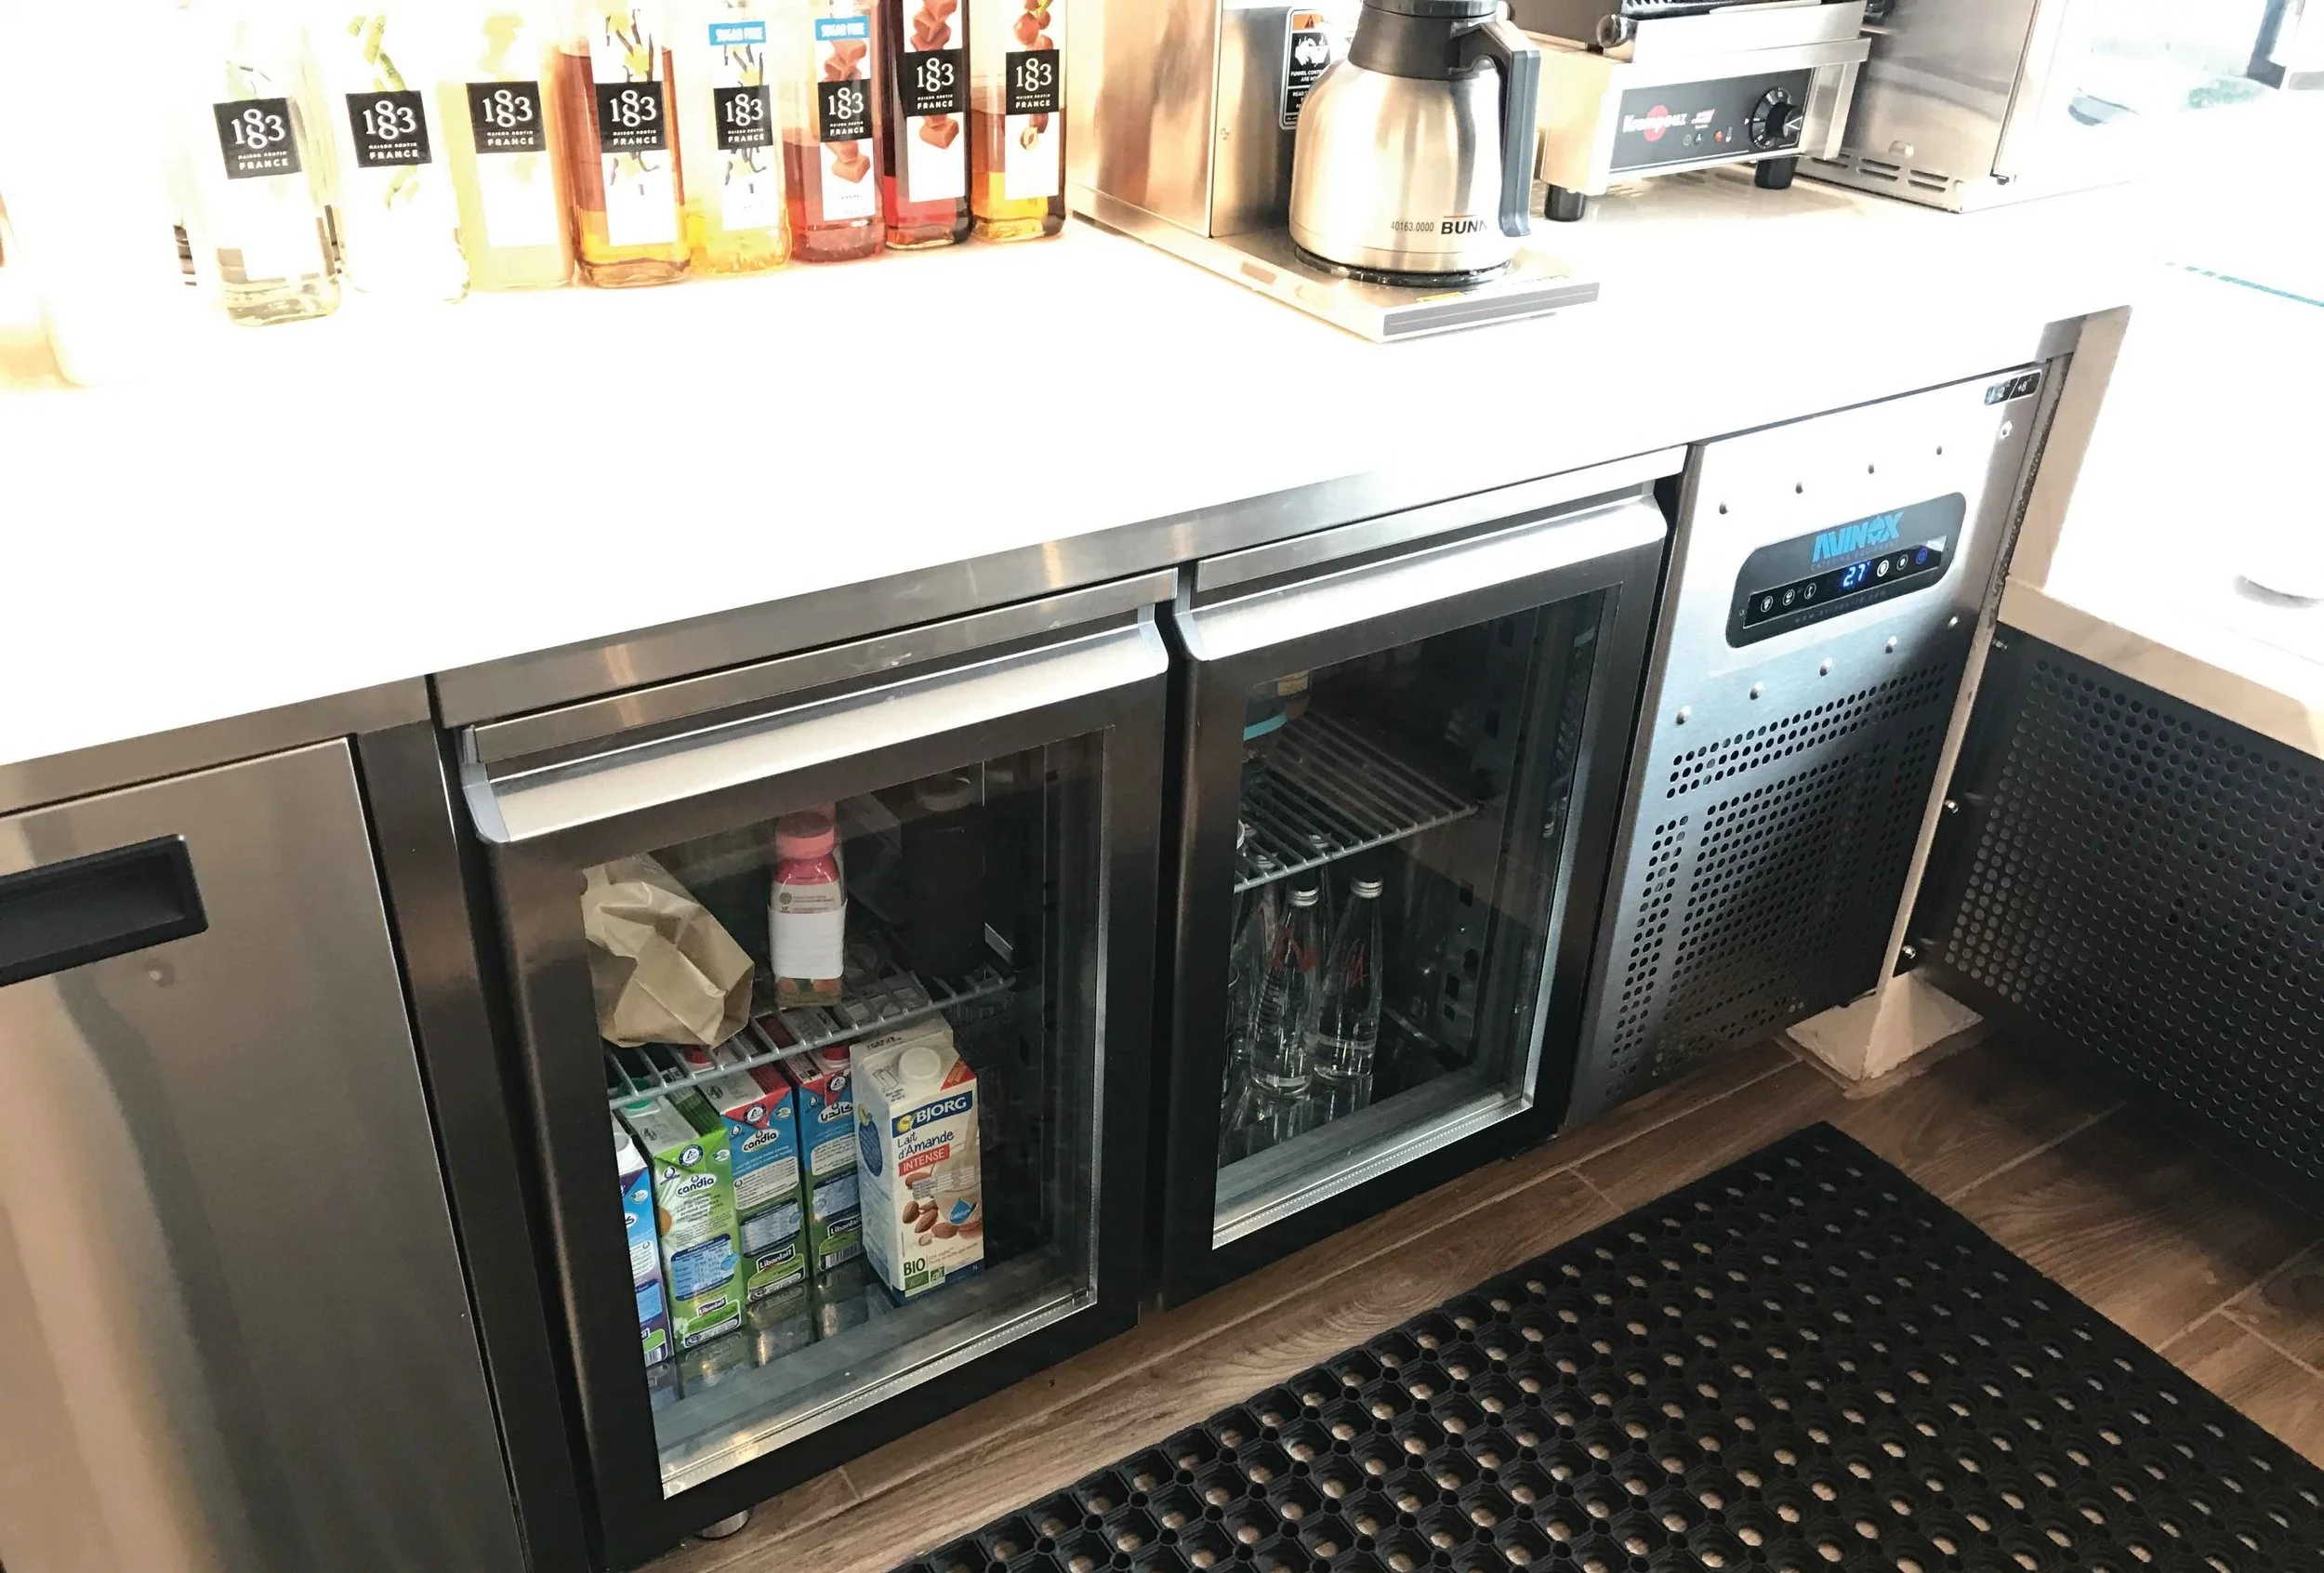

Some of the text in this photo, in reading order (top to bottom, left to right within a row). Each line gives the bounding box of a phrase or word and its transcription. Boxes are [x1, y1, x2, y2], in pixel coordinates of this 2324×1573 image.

[917, 100, 953, 110] FRANCE
[1015, 99, 1050, 109] FRANCE
[829, 126, 864, 136] FRANCE
[487, 137, 535, 146] FRANCE
[613, 136, 657, 145] FRANCE
[728, 133, 764, 143] FRANCE
[369, 149, 418, 159] FRANCE
[239, 158, 289, 170] FRANCE
[1390, 220, 1434, 232] 40163.0000
[1812, 511, 1904, 563] AVINOX
[917, 1096, 967, 1123] BJORG
[743, 1130, 777, 1151] candia
[897, 1131, 918, 1149] Lait
[898, 1130, 955, 1160] d'Amande
[903, 1148, 945, 1172] INTENSE
[677, 1176, 715, 1196] candia
[903, 1258, 926, 1276] BIO
